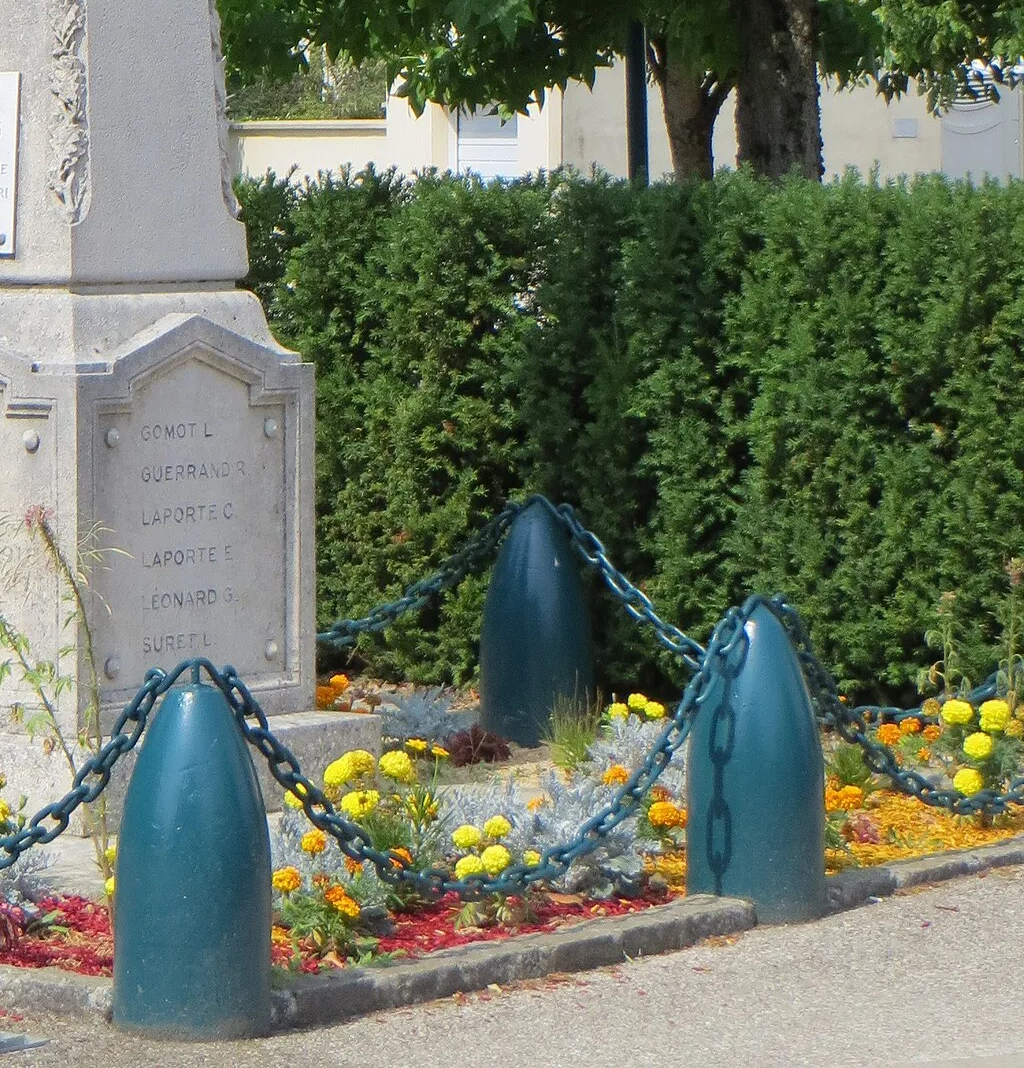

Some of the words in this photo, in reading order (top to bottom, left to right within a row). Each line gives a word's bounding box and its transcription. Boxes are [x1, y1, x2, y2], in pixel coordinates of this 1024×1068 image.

[141, 423, 196, 441] GOMOT
[141, 461, 230, 483] GUERRAND
[142, 504, 217, 526] LAPORTE
[142, 546, 217, 568] LAPORTE
